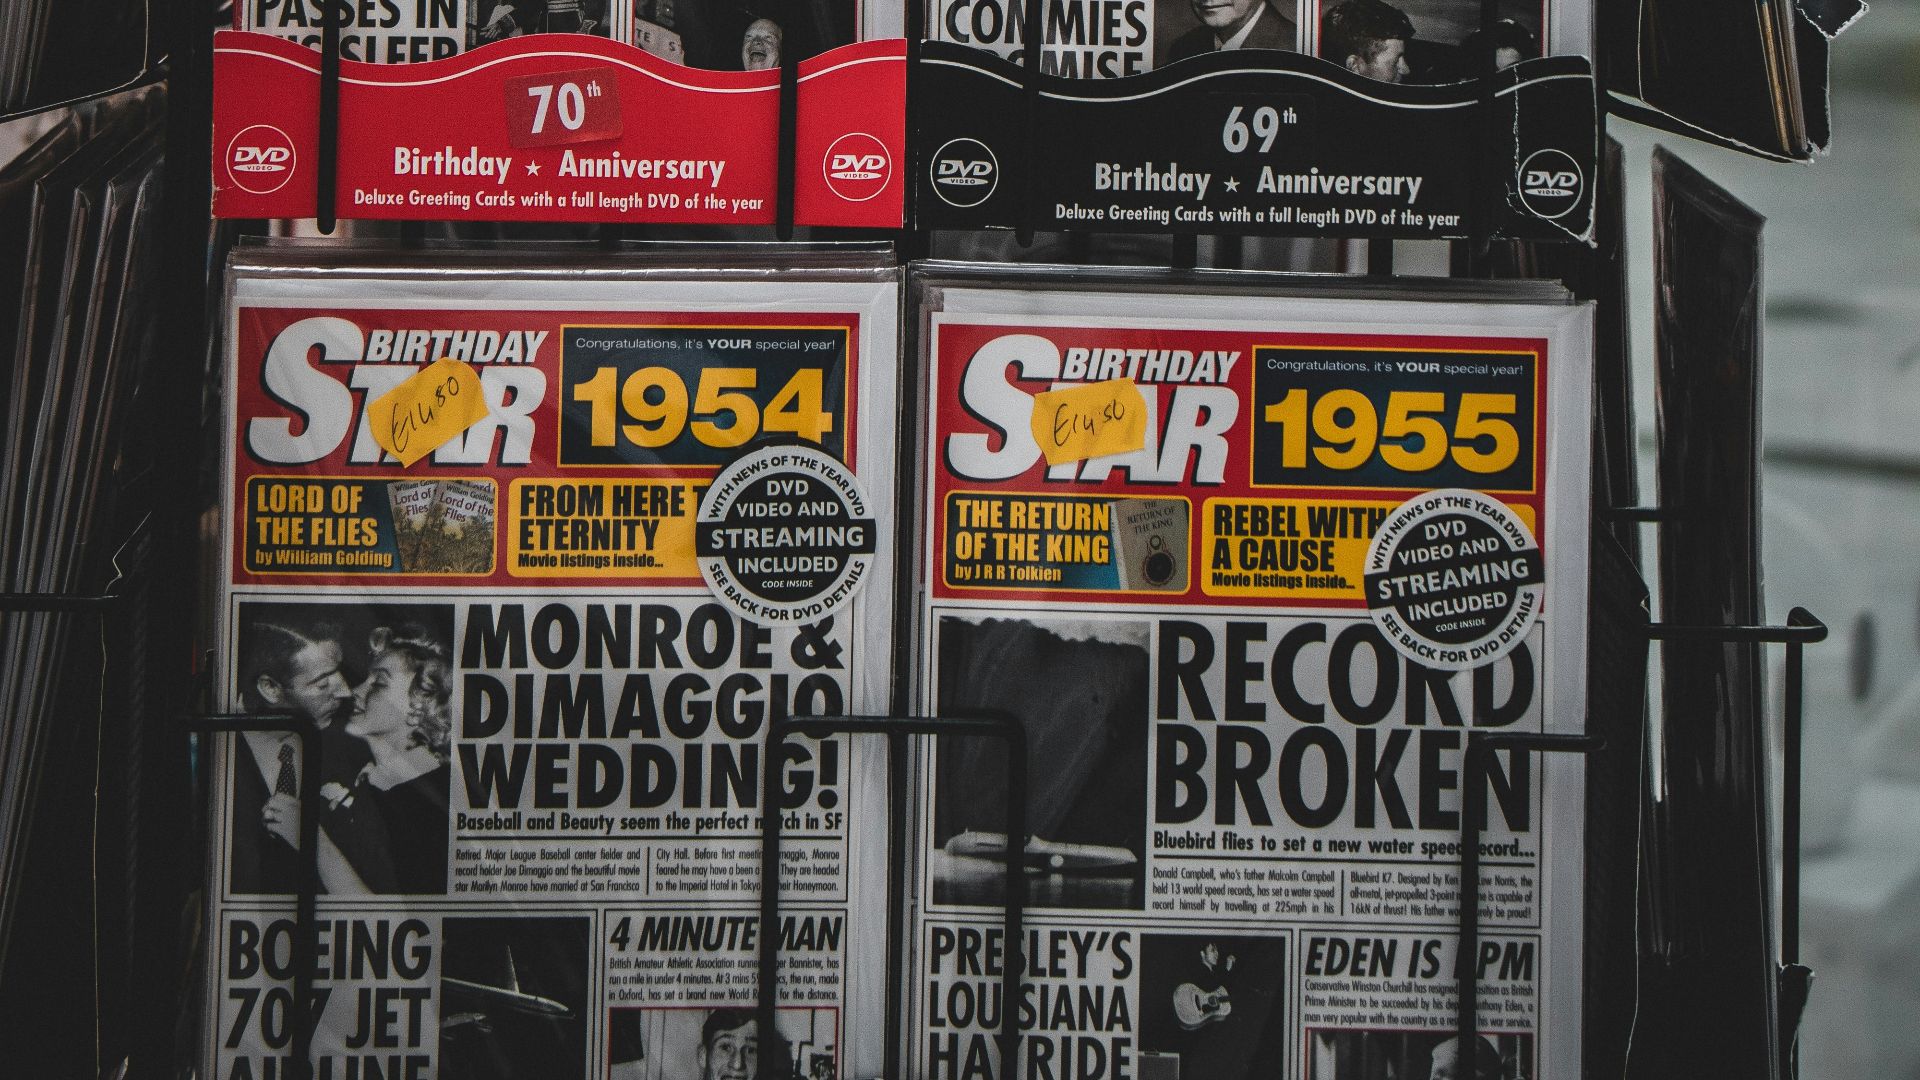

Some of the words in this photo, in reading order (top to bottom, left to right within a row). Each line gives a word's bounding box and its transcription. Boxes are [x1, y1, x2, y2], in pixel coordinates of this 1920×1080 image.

[235, 147, 290, 163] DVD
[395, 146, 512, 184] Birthday
[558, 150, 725, 187] Anniversary
[831, 154, 885, 172] DVD
[939, 160, 992, 177] DVD
[1096, 162, 1211, 200] Birthday
[1257, 166, 1422, 204] Anniversary
[1526, 171, 1578, 186] DVD
[355, 189, 403, 205] Deluxe
[409, 190, 470, 210] Greeting
[476, 191, 515, 206] Cards
[521, 192, 552, 206] with
[558, 197, 566, 207] a
[572, 191, 593, 207] full
[600, 192, 642, 212] length
[648, 194, 679, 208] DVD
[685, 193, 699, 208] of
[704, 194, 726, 209] the
[732, 199, 763, 213] year
[1056, 204, 1104, 219] Deluxe
[1109, 205, 1169, 225] Greeting
[1175, 206, 1213, 221] Cards
[1219, 206, 1250, 222] with
[1256, 212, 1264, 222] a
[1269, 207, 1291, 222] full
[1297, 207, 1339, 227] length
[1345, 209, 1376, 224] DVD
[1381, 209, 1396, 224] of
[1401, 209, 1423, 225] the
[1428, 214, 1460, 230] year
[366, 330, 549, 362] BIRTHDAY
[576, 337, 680, 350] Congratulations,
[685, 338, 703, 349] it's
[707, 339, 751, 349] YOUR
[755, 339, 800, 351] special
[804, 340, 835, 351] year!
[1063, 348, 1241, 383] BIRTHDAY
[1267, 359, 1370, 372] Congratulations,
[1374, 361, 1392, 371] it's
[1396, 362, 1440, 372] YOUR
[1444, 364, 1488, 375] special
[1492, 365, 1523, 376] year!
[574, 367, 832, 448] 1954
[1265, 389, 1519, 473] 1955
[257, 485, 324, 513] LORD
[332, 485, 363, 514] OF
[520, 485, 603, 516] FROM
[613, 485, 685, 516] HERE
[708, 484, 734, 519] WITH
[732, 459, 768, 487] NEWS
[771, 455, 788, 466] OF
[792, 456, 818, 470] THE
[821, 462, 849, 491] YEAR
[846, 489, 865, 515] DVD
[767, 480, 809, 496] DVD
[737, 503, 792, 517] VIDEO
[798, 502, 839, 516] AND
[955, 500, 1002, 528] THE
[1010, 501, 1111, 531] RETURN
[1214, 505, 1300, 537] REBEL
[256, 518, 303, 545] THE
[311, 518, 377, 546] FLIES
[520, 519, 660, 550] ETERNITY
[711, 526, 863, 549] STREAMING
[1372, 531, 1394, 570] WITH
[1389, 505, 1423, 534] NEWS
[1425, 497, 1442, 511] OF
[1444, 497, 1472, 508] THE
[1475, 500, 1505, 526] YEAR
[1504, 522, 1525, 547] DVD
[1425, 520, 1467, 540] DVD
[256, 550, 271, 565] by
[276, 550, 332, 565] William
[336, 551, 392, 568] Golding
[518, 554, 557, 567] Movie
[561, 554, 610, 568] listings
[955, 531, 987, 560] OF
[993, 533, 1039, 561] THE
[1047, 535, 1109, 564] KING
[1212, 538, 1232, 570] A
[1239, 539, 1334, 571] CAUSE
[1398, 544, 1453, 566] VIDEO
[1459, 537, 1500, 556] AND
[738, 557, 838, 574] INCLUDED
[955, 564, 971, 580] by
[975, 565, 980, 579] J
[984, 566, 993, 579] R
[997, 566, 1005, 580] R
[1010, 565, 1061, 581] Tolkien
[1378, 558, 1529, 599] STREAMING
[710, 563, 728, 587] SEE
[724, 585, 757, 614] BACK
[761, 608, 789, 620] FOR
[793, 604, 822, 619] DVD
[823, 561, 865, 609] DETAILS
[762, 580, 784, 588] CODE
[787, 580, 813, 588] INSIDE
[1212, 573, 1250, 587] Movie
[1254, 574, 1302, 589] listings
[1408, 591, 1507, 621] INCLUDED
[461, 603, 772, 669] MONROE
[790, 615, 844, 669] &
[1381, 613, 1402, 637] SEE
[1400, 633, 1435, 660] BACK
[1439, 650, 1468, 662] FOR
[1472, 640, 1499, 660] DVD
[1499, 591, 1534, 644] DETAILS
[1436, 622, 1458, 633] CODE
[1459, 618, 1486, 629] INSIDE
[462, 673, 843, 739] DIMAGGIO
[457, 740, 839, 809] WEDDING!
[1155, 724, 1530, 832] BROKEN
[457, 812, 521, 830] Baseball
[527, 812, 554, 830] and
[561, 813, 615, 835] Beauty
[620, 815, 659, 830] seem
[666, 812, 690, 829] the
[696, 812, 749, 834] perfect
[806, 813, 819, 829] in
[825, 813, 842, 830] SF
[1154, 831, 1215, 850] Bluebird
[1222, 831, 1253, 850] flies
[1261, 835, 1276, 850] to
[1283, 836, 1306, 851] set
[1312, 838, 1322, 851] a
[1329, 838, 1361, 853] new
[1368, 840, 1414, 854] water
[1153, 867, 1177, 878] Donald
[1181, 868, 1216, 881] Campbell,
[1220, 868, 1240, 880] who's
[1244, 869, 1265, 881] father
[1269, 870, 1298, 881] Malcolm
[1302, 871, 1334, 882] Campbell
[610, 917, 631, 950] 4
[637, 917, 759, 951] MINUTE
[610, 958, 631, 969] British
[634, 958, 664, 969] Amateur
[667, 957, 693, 968] Athletic
[696, 957, 735, 968] Association
[1305, 937, 1397, 977] EDEN
[1408, 940, 1442, 978] IS
[1305, 979, 1350, 991] Conservative
[1352, 980, 1381, 991] Winston
[1383, 981, 1412, 992] Churchill
[346, 988, 431, 1048] JET
